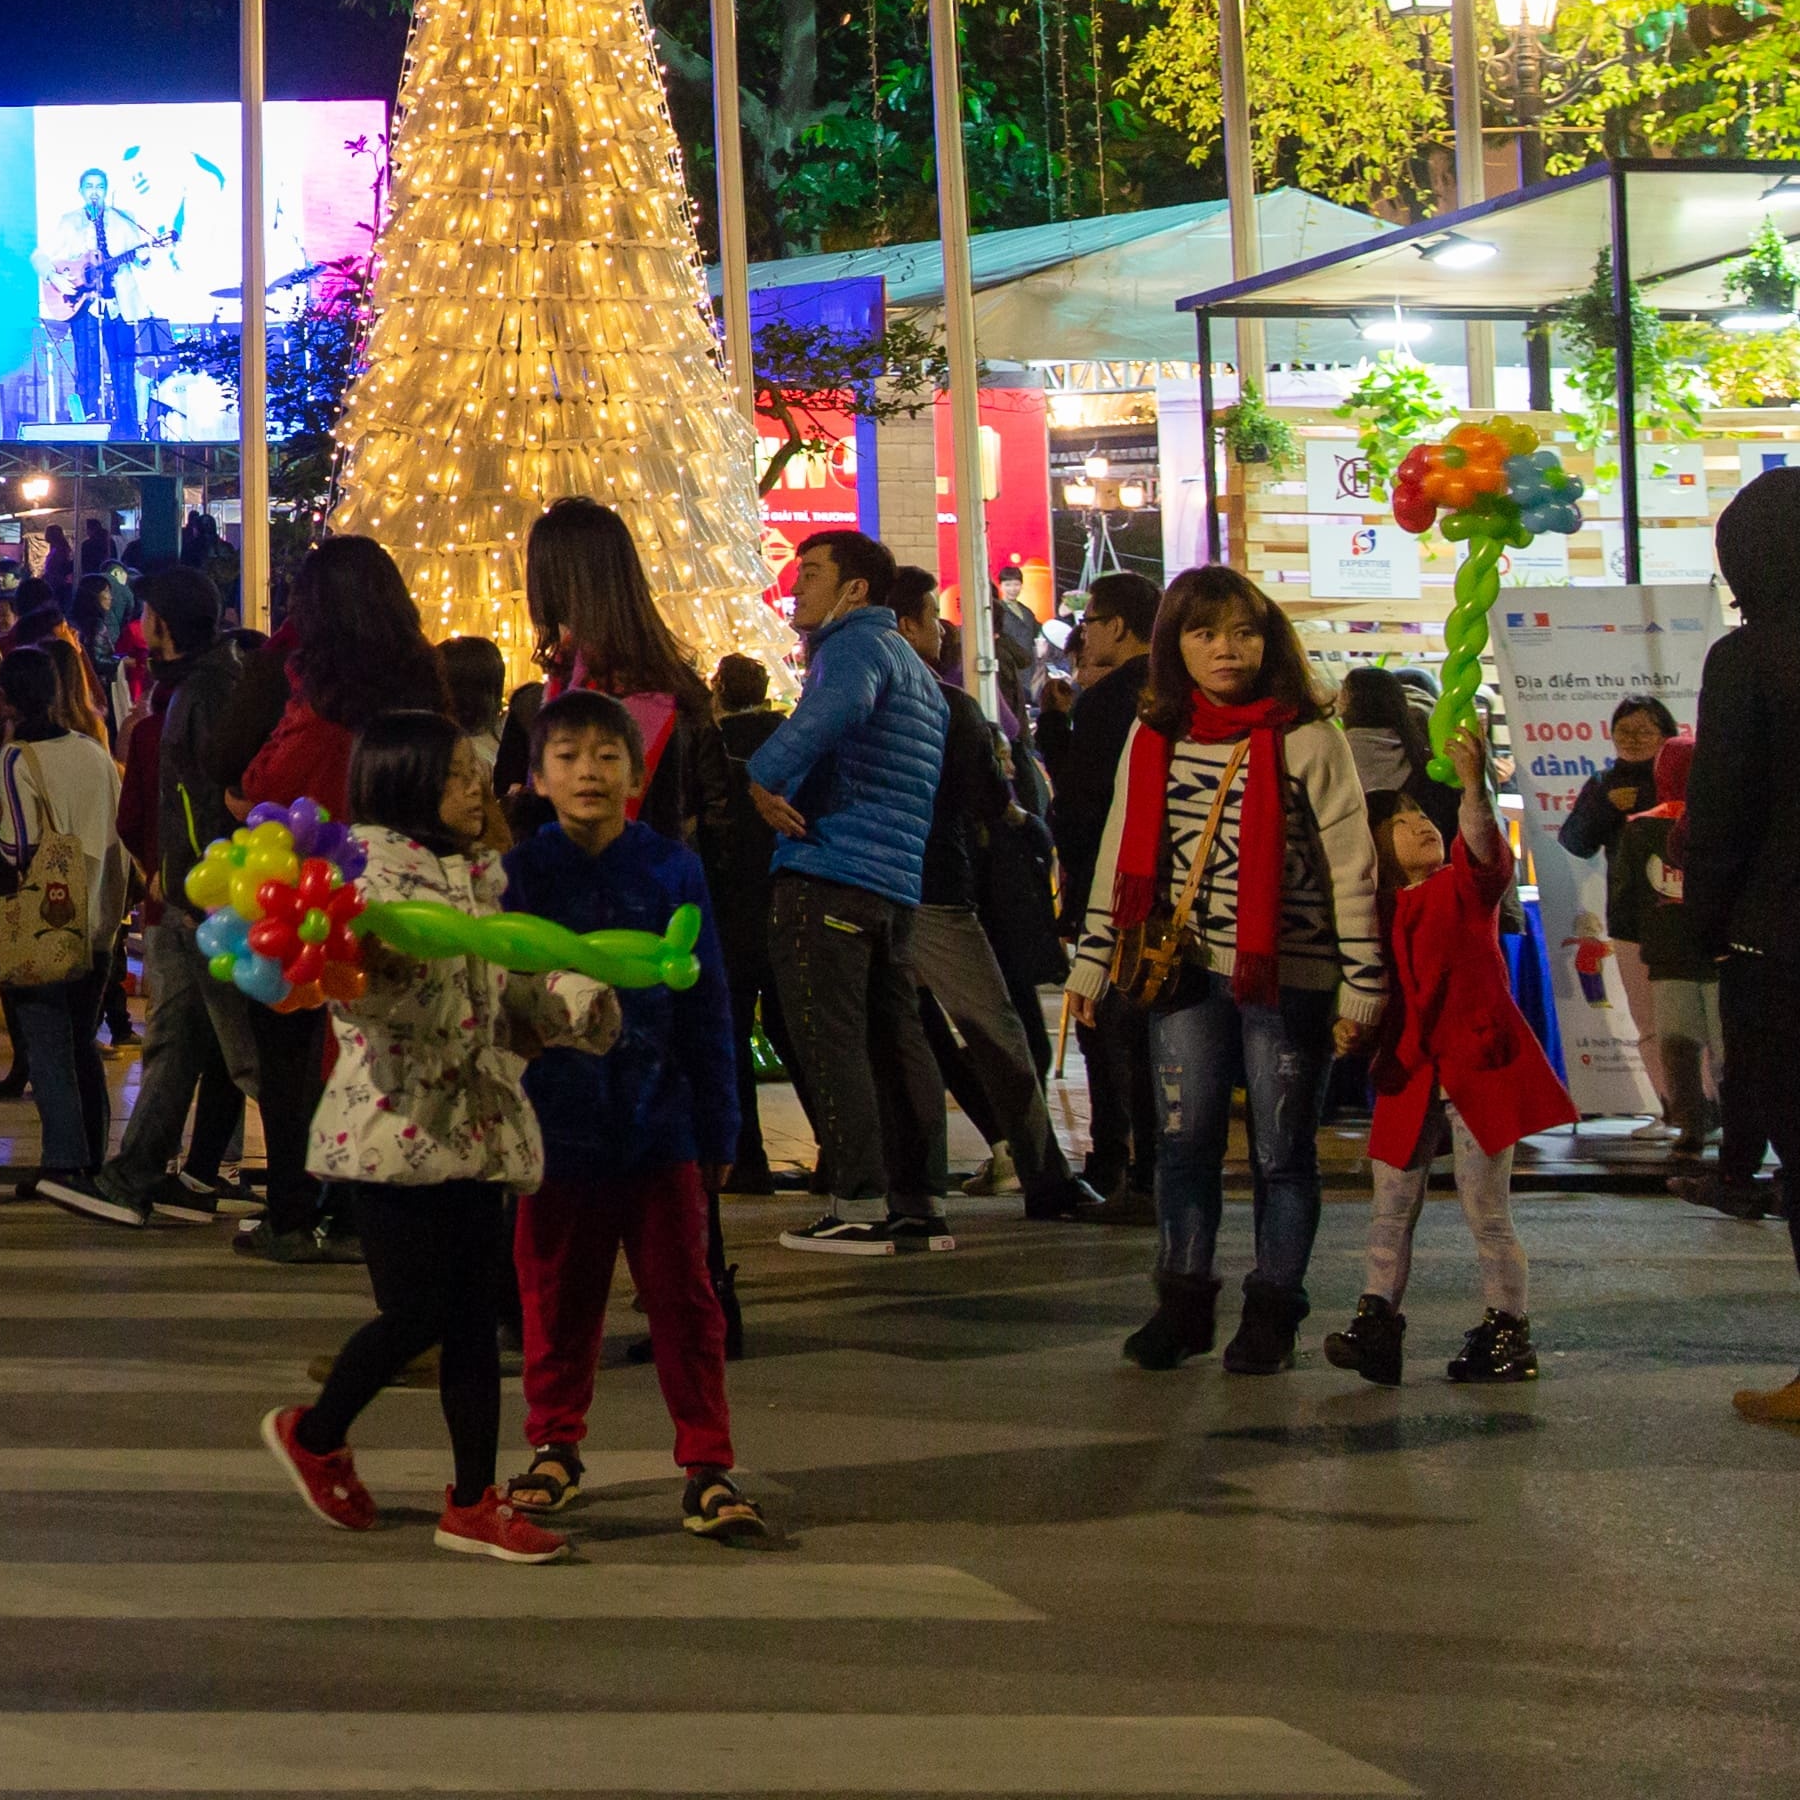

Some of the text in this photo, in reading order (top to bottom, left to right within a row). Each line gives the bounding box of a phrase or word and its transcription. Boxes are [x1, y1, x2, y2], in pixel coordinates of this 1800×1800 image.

[1595, 673, 1625, 687] thu
[1518, 691, 1549, 702] Point
[1551, 690, 1567, 701] de
[1571, 690, 1619, 701] collecte
[1524, 722, 1592, 741] 1000
[1531, 754, 1596, 776] dành
